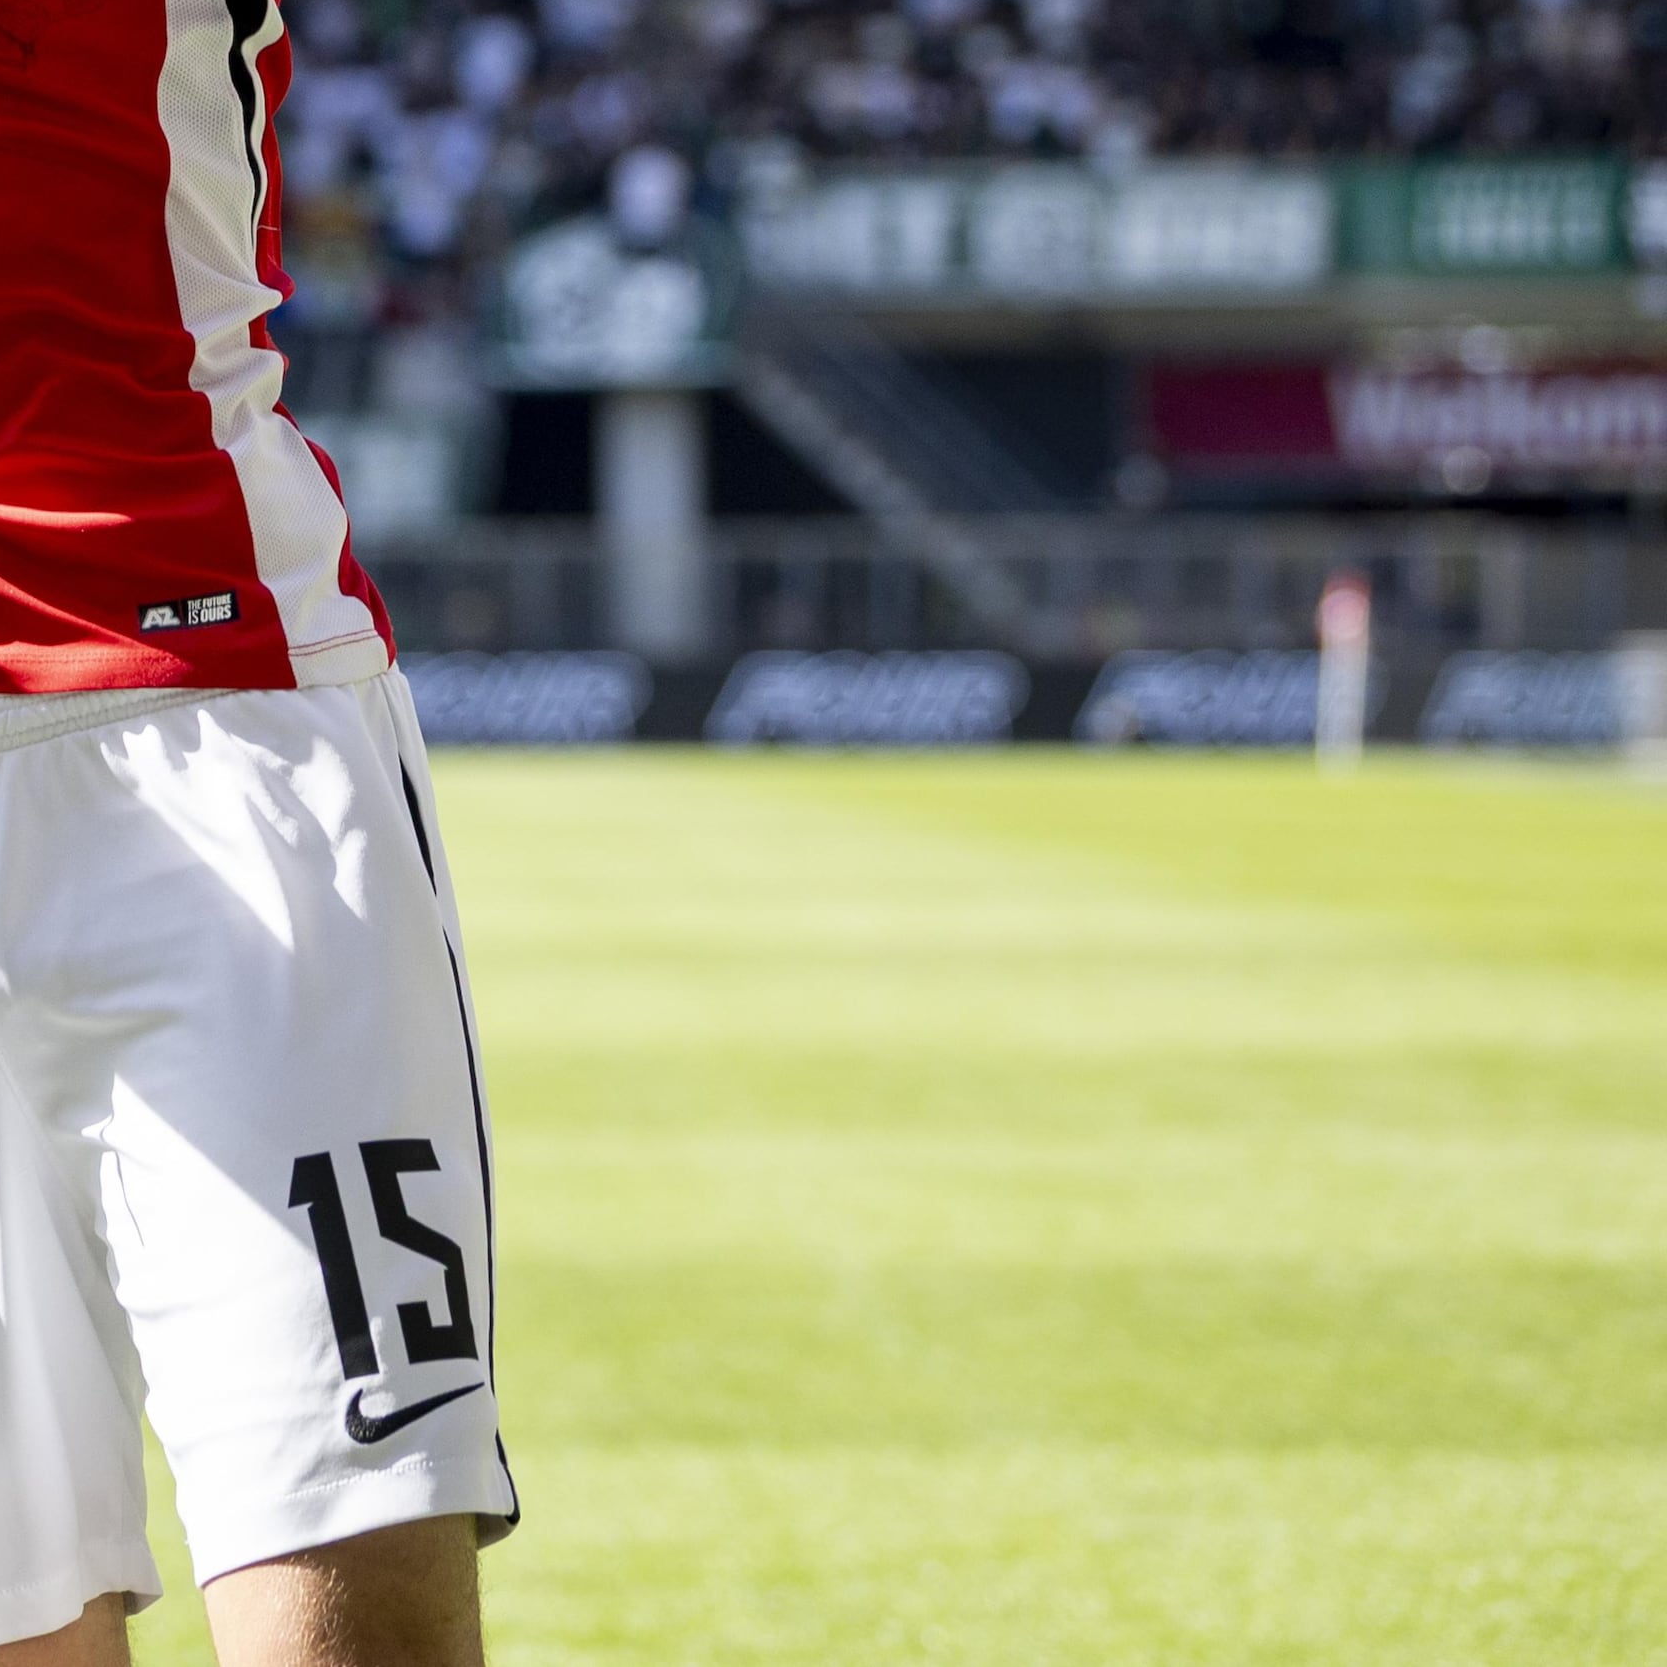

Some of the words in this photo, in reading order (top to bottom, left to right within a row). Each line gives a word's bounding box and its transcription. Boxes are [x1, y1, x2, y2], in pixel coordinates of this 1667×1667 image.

[187, 599, 202, 610] THE
[202, 593, 232, 608] FUTURE
[141, 605, 181, 630] AZ
[188, 610, 199, 625] IS
[200, 605, 232, 623] OURS
[288, 1137, 479, 1382] 15
